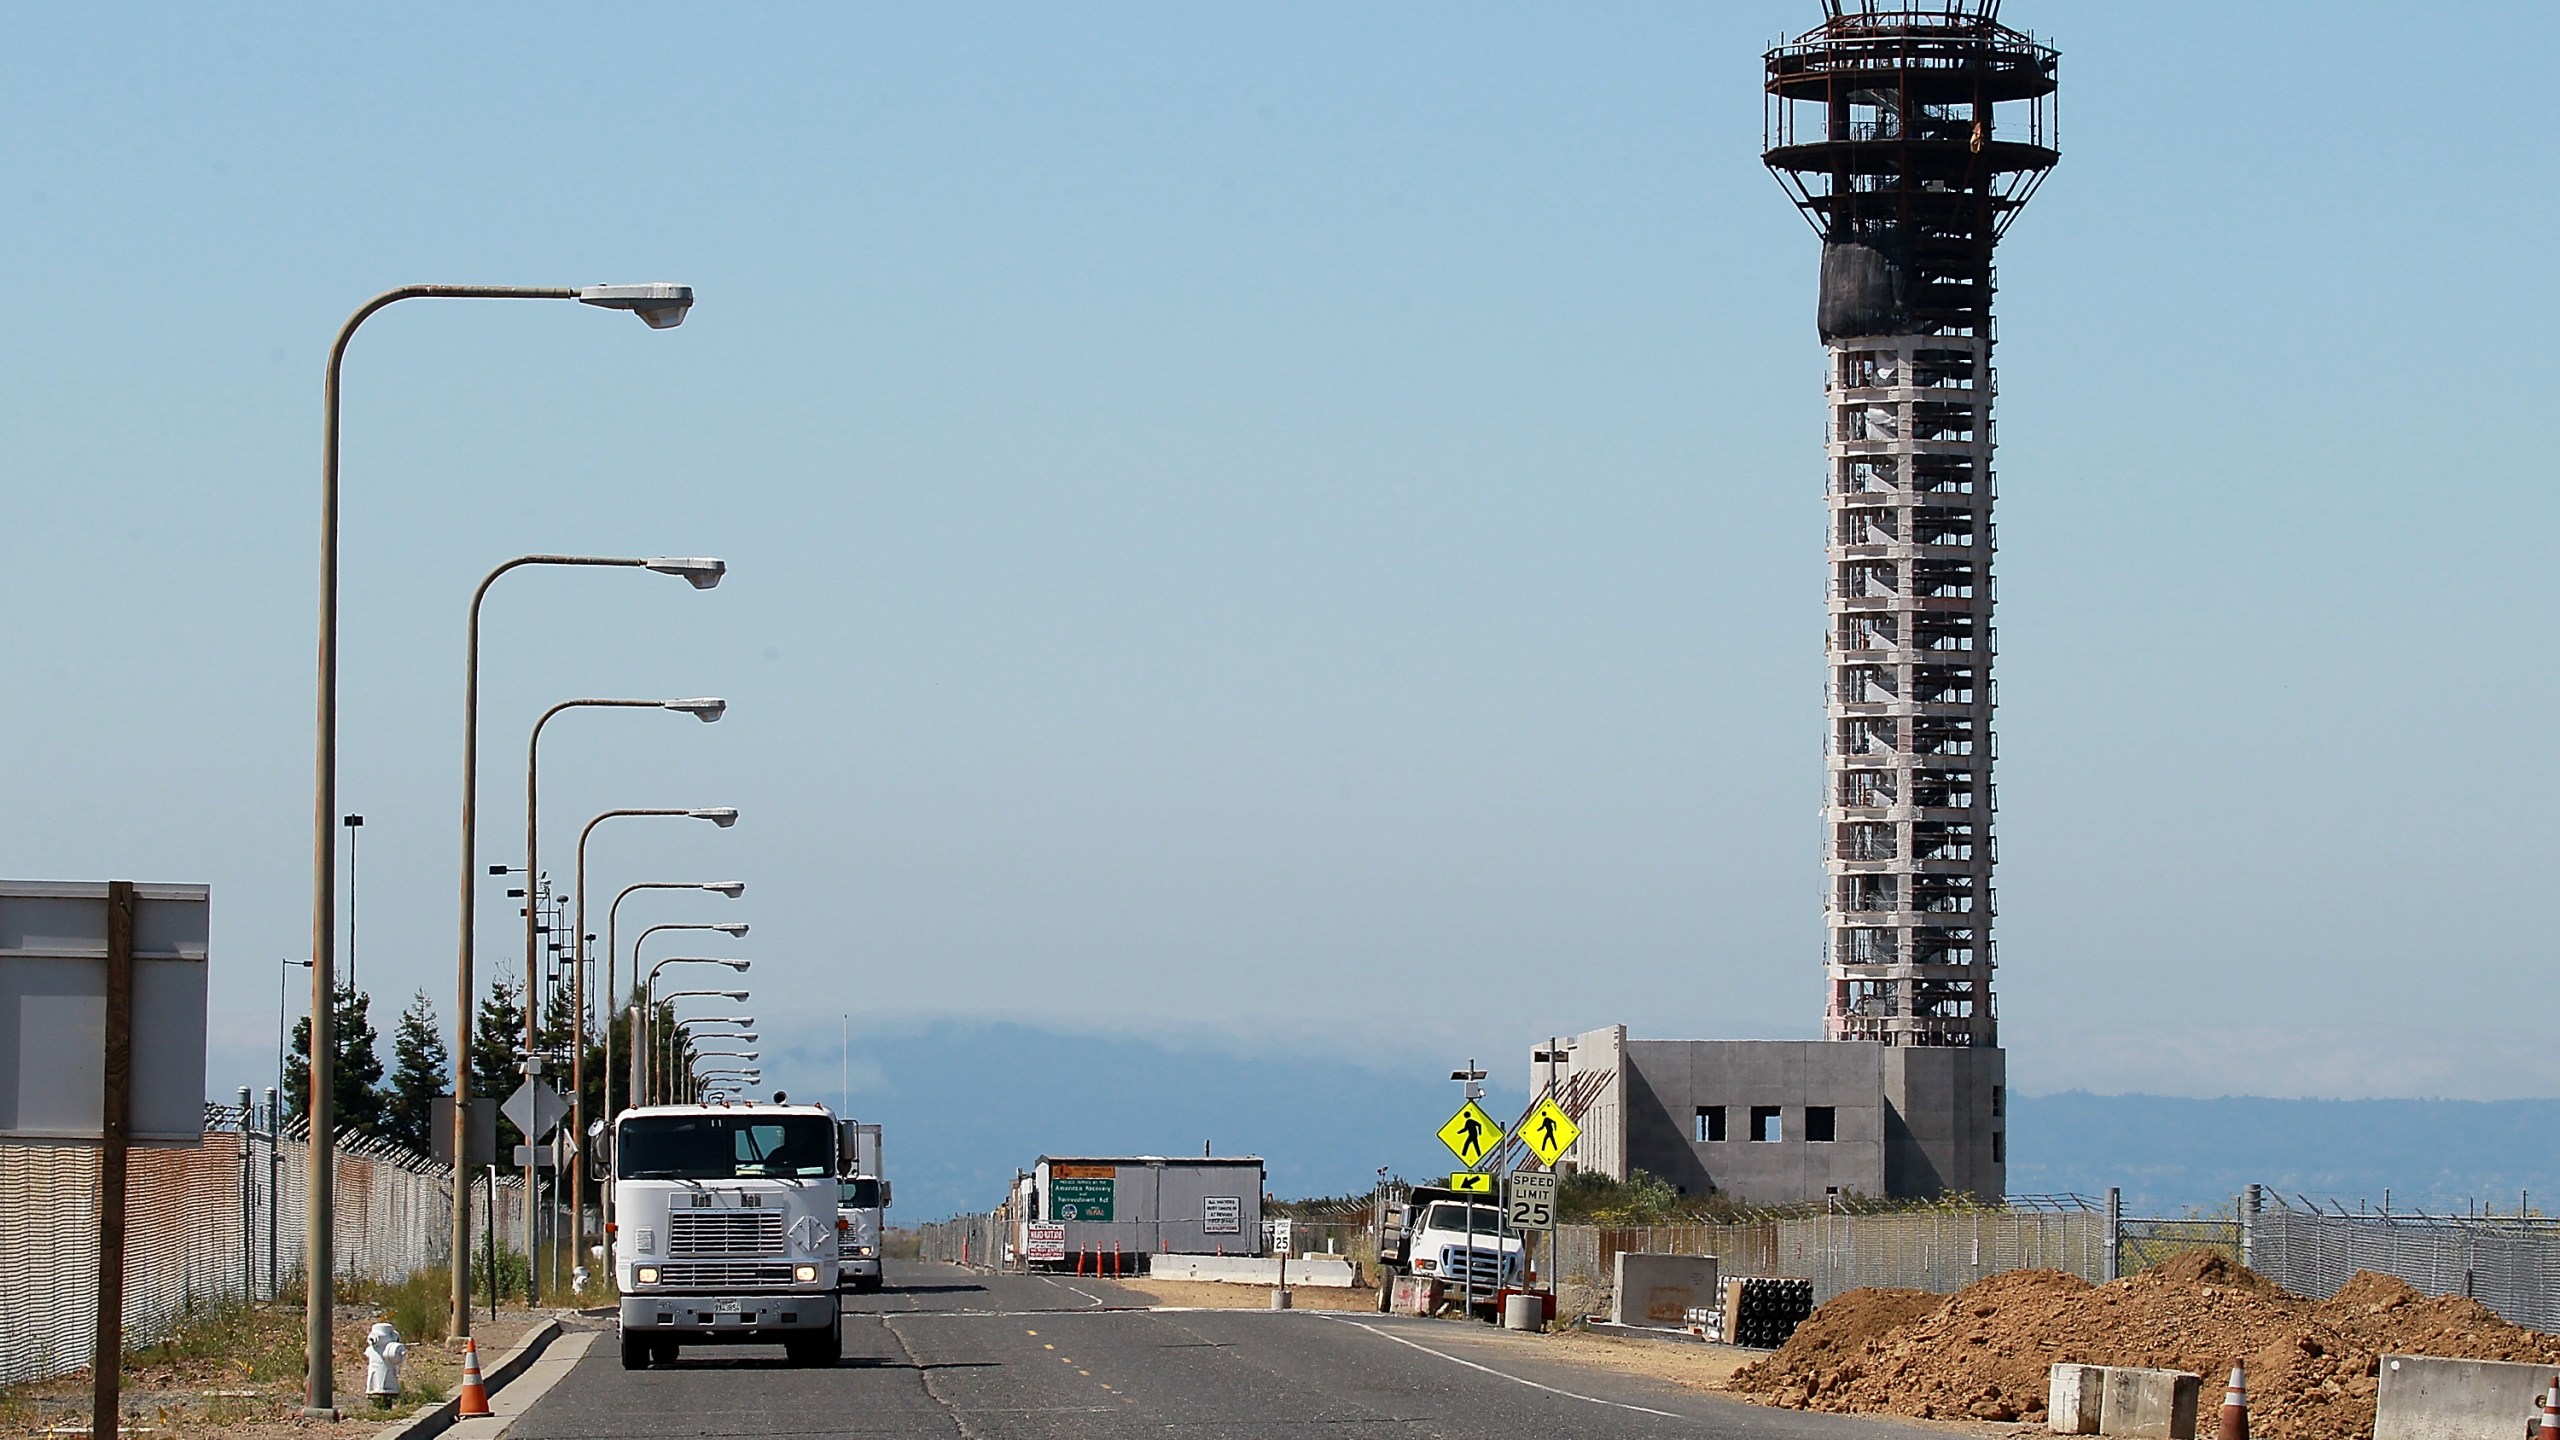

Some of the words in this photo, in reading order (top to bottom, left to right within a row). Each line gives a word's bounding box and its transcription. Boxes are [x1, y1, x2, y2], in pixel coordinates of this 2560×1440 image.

[1513, 1175, 1554, 1187] SPEED
[1085, 1185, 1111, 1193] Recovery
[1516, 1188, 1550, 1200] LIMIT
[1512, 1202, 1550, 1226] 25
[1276, 1237, 1289, 1249] 25
